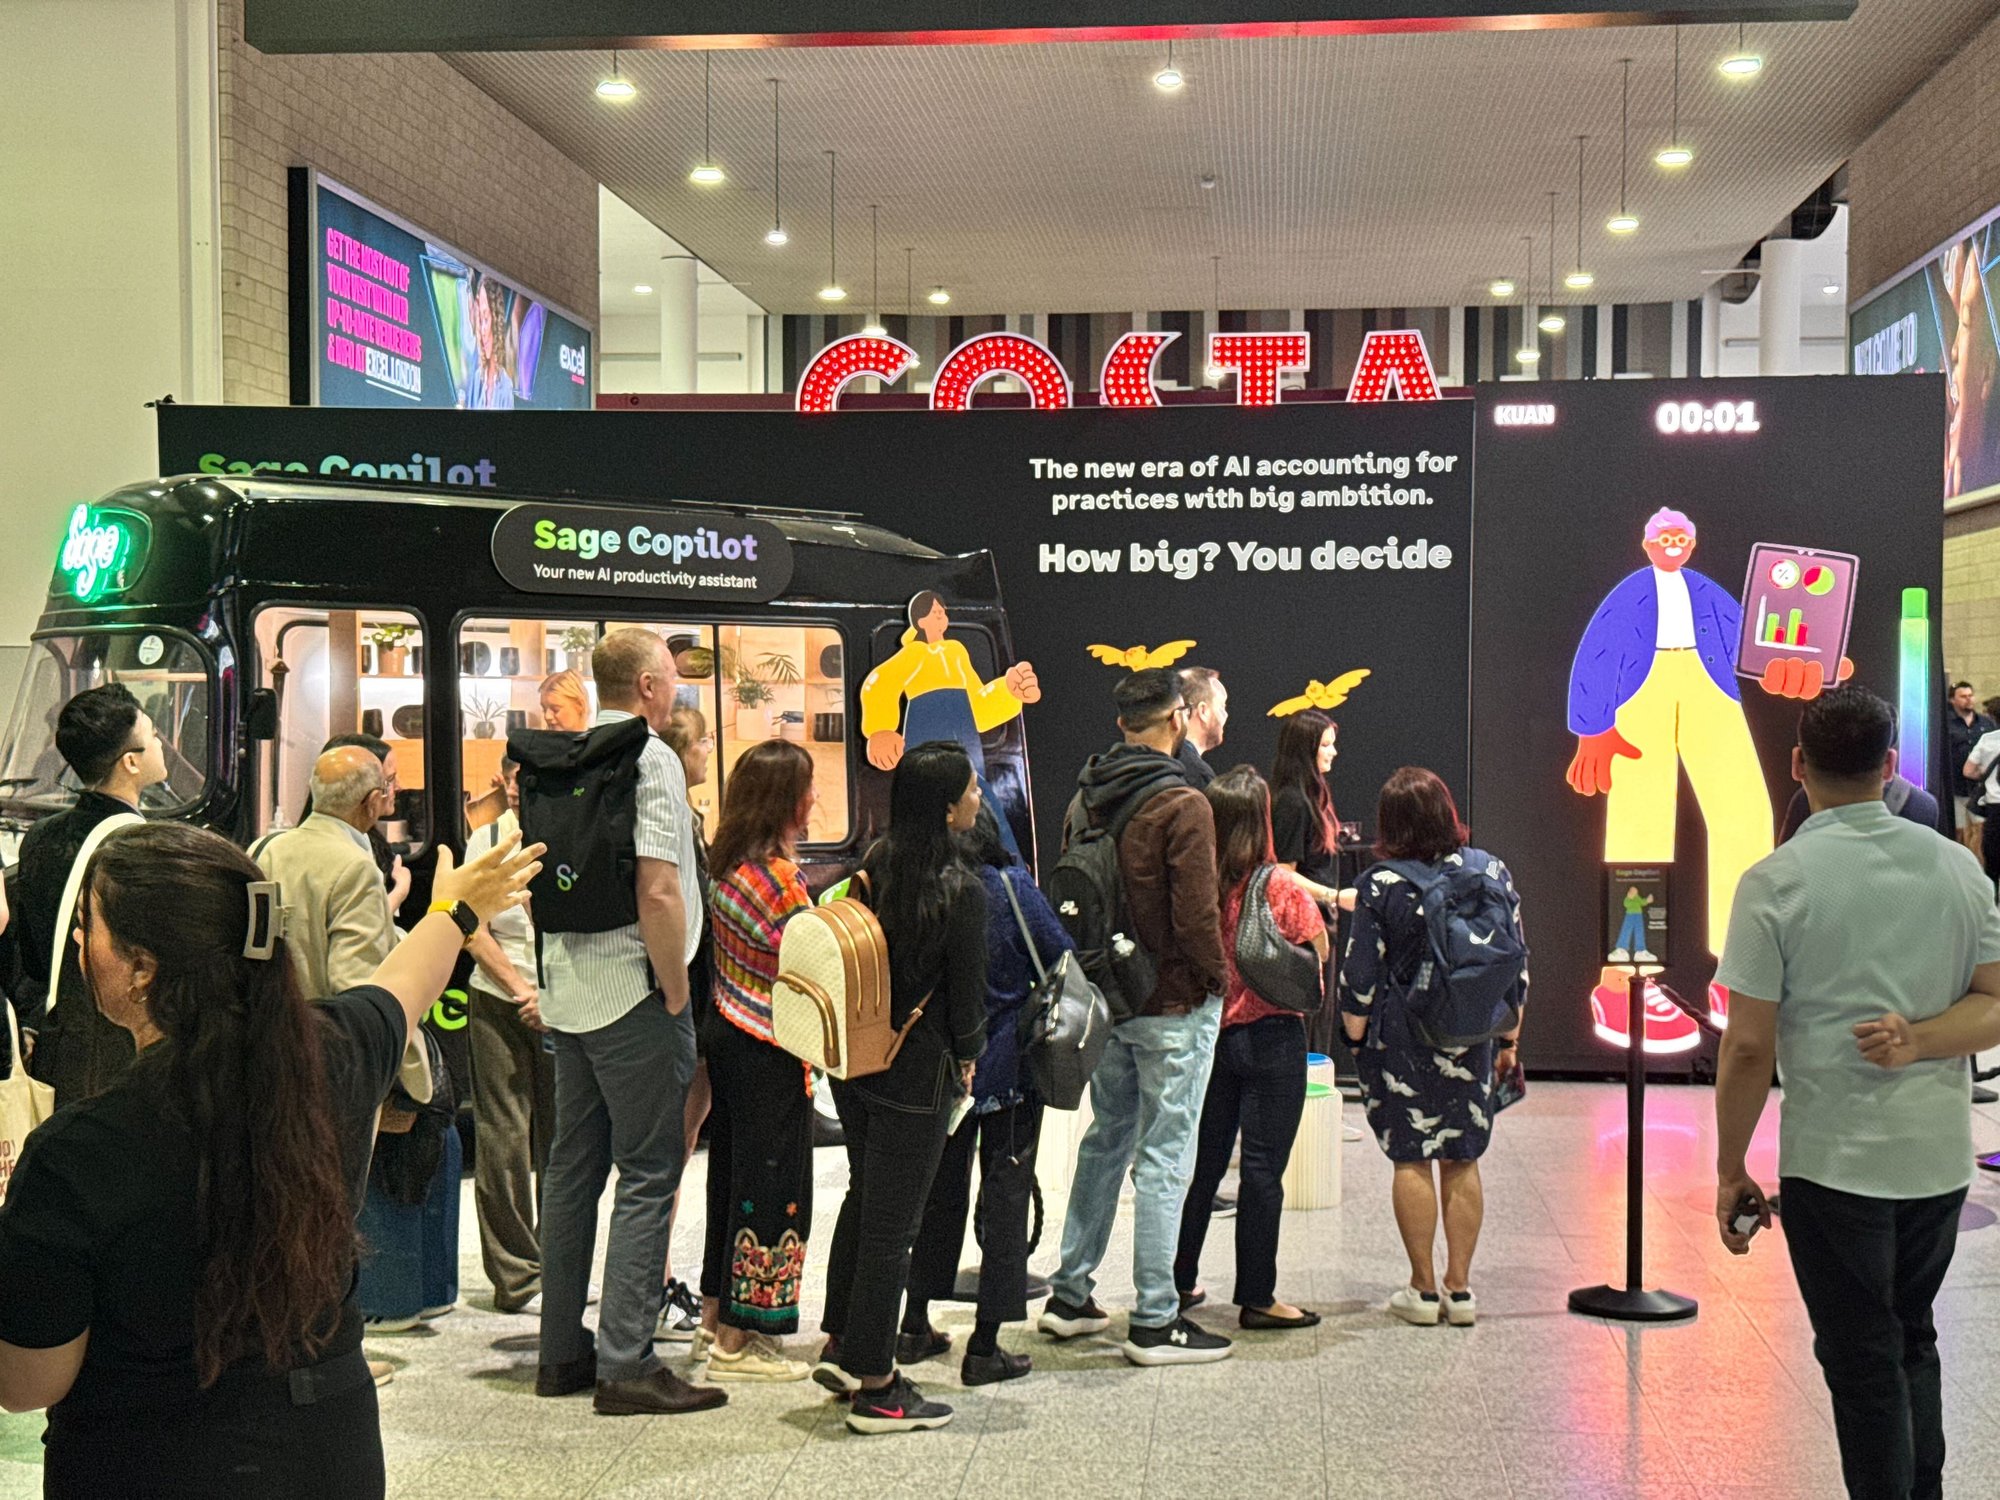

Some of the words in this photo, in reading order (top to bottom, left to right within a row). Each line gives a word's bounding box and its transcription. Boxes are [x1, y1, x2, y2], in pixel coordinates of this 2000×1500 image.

[560, 344, 585, 377] excel
[1494, 404, 1556, 426] KUAN
[1656, 401, 1760, 434] 00:01
[1029, 457, 1078, 479] The
[1084, 461, 1135, 479] new
[1141, 459, 1183, 478] era
[1189, 454, 1218, 477] of
[1224, 456, 1250, 477] AI
[1256, 451, 1410, 479] accounting
[1416, 450, 1458, 473] for
[1052, 488, 1179, 515] practices
[1185, 486, 1243, 509] with
[1250, 485, 1295, 513] big
[1300, 483, 1434, 508] ambition.
[533, 519, 621, 560] Sage
[628, 526, 758, 565] Copilot
[1039, 543, 1121, 573] How
[1130, 539, 1222, 580] big?
[1228, 541, 1302, 572] You
[1311, 536, 1452, 571] decide
[533, 563, 566, 579] Your
[568, 569, 594, 581] new
[597, 568, 611, 581] AI
[614, 569, 697, 589] productivity
[699, 574, 758, 589] assistant
